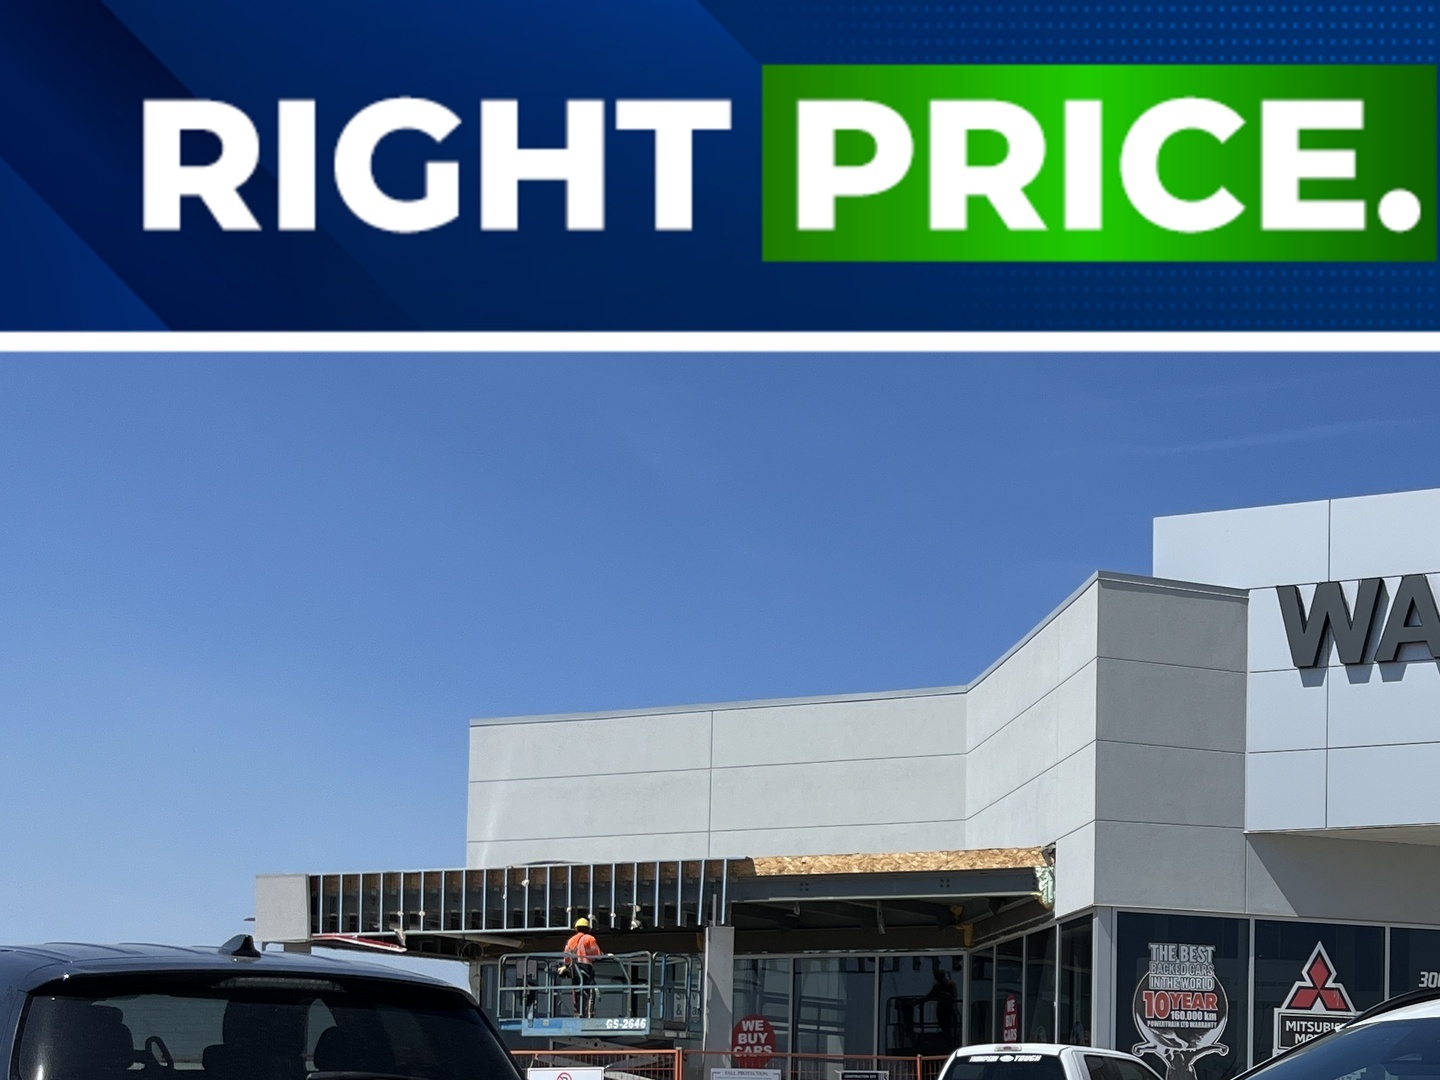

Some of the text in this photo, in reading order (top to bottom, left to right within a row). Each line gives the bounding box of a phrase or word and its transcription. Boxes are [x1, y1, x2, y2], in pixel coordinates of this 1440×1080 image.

[1149, 944, 1215, 963] THE BEST
[1151, 963, 1215, 976] BACKED CARS
[1151, 976, 1160, 988] IN
[1160, 976, 1180, 989] THE
[1180, 977, 1214, 990] WORLD
[1006, 1000, 1015, 1012] WE
[1143, 991, 1218, 1019] 10 YEAR
[1005, 1014, 1016, 1027] BUY
[1170, 1011, 1217, 1021] 160,000 km
[606, 1018, 647, 1029] GS-2646
[742, 1020, 764, 1031] WE
[1285, 1021, 1342, 1034] MITSUBI
[738, 1032, 768, 1044] BUY
[1004, 1029, 1017, 1041] CARS
[734, 1045, 773, 1057] CARS
